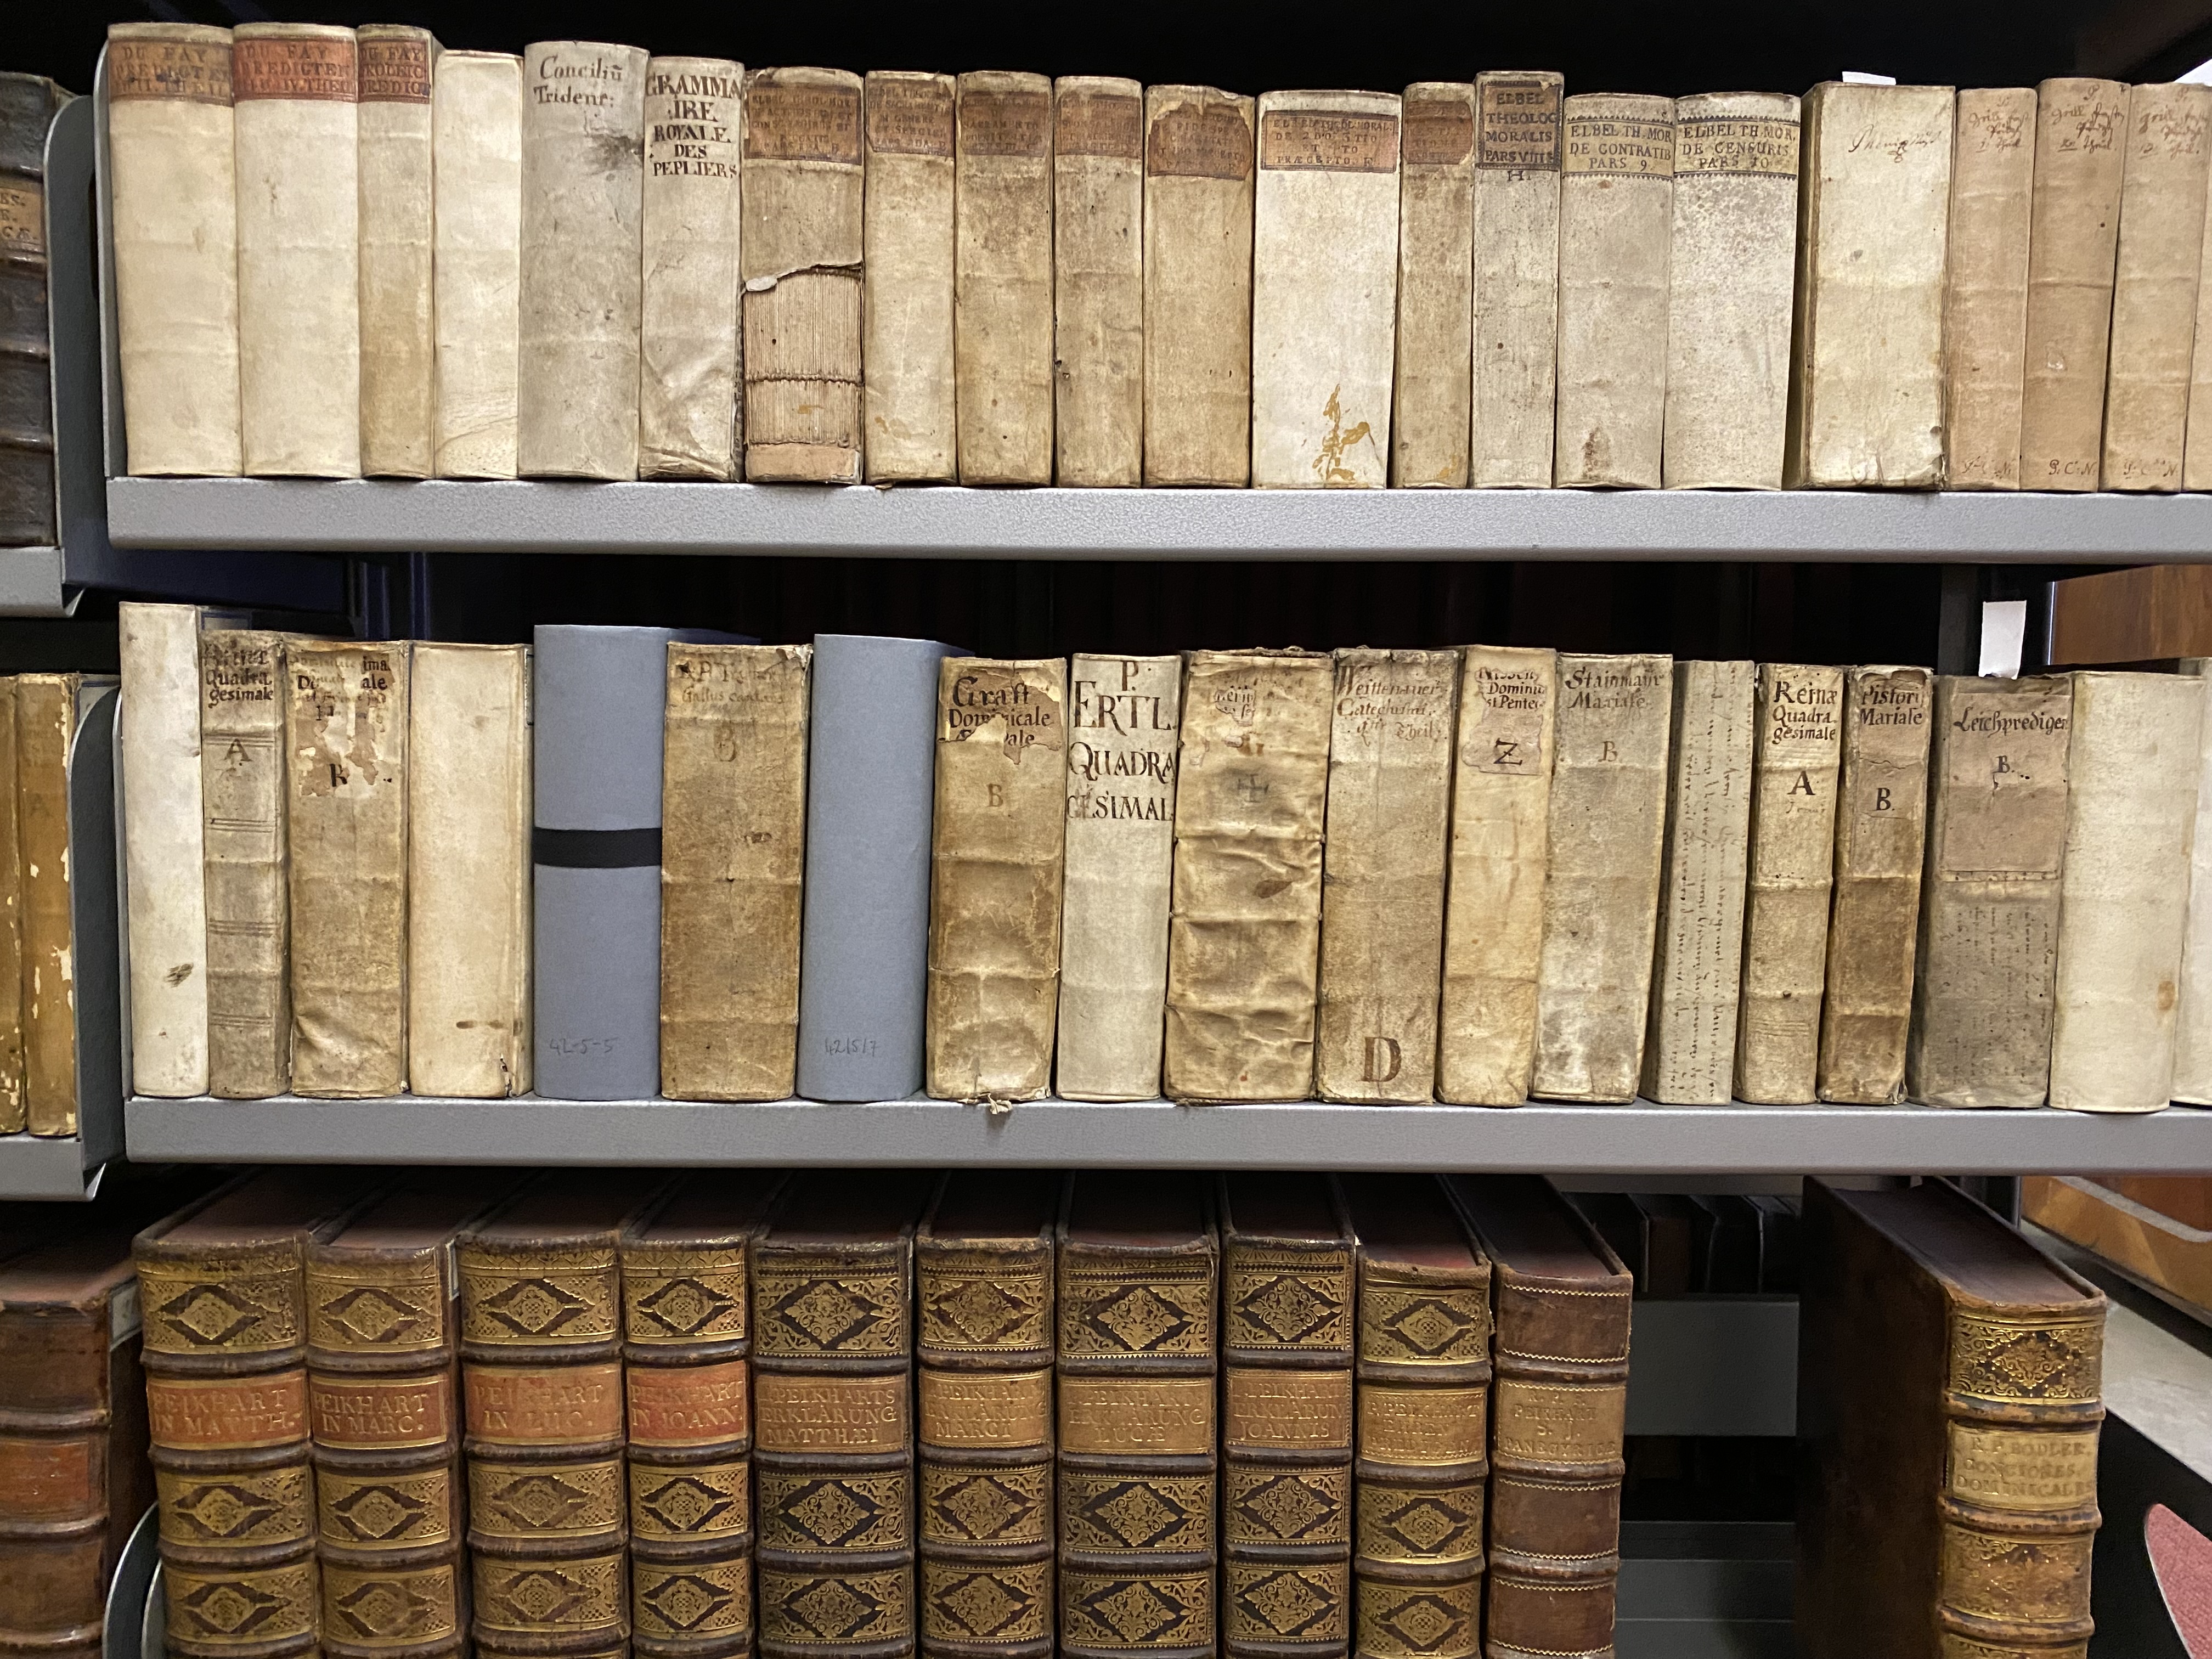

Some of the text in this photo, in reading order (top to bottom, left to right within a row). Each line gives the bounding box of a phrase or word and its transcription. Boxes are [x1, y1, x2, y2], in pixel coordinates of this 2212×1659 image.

[645, 74, 742, 99] GRAMMA
[1496, 92, 1546, 105] ELBEL
[1486, 111, 1559, 125] THEOLOG
[653, 124, 732, 143] ROYALE
[1485, 130, 1553, 143] MORALIS
[1570, 124, 1619, 138] ELBEL
[1683, 124, 1735, 139] ELBEL
[674, 144, 707, 159] DES
[1485, 150, 1516, 162] PARS
[1570, 143, 1590, 157] DE
[1682, 142, 1790, 156] DE CENSURIS
[653, 160, 738, 179] PEPLIERS
[1589, 157, 1628, 170] PARS
[1699, 155, 1740, 170] PARS
[1772, 725, 1836, 745] gesimale
[1493, 737, 1523, 766] Z
[1598, 740, 1618, 763] B
[1070, 741, 1175, 785] QUADRA
[1786, 770, 1816, 796] A
[988, 783, 1004, 807] B
[1357, 1036, 1402, 1082] D
